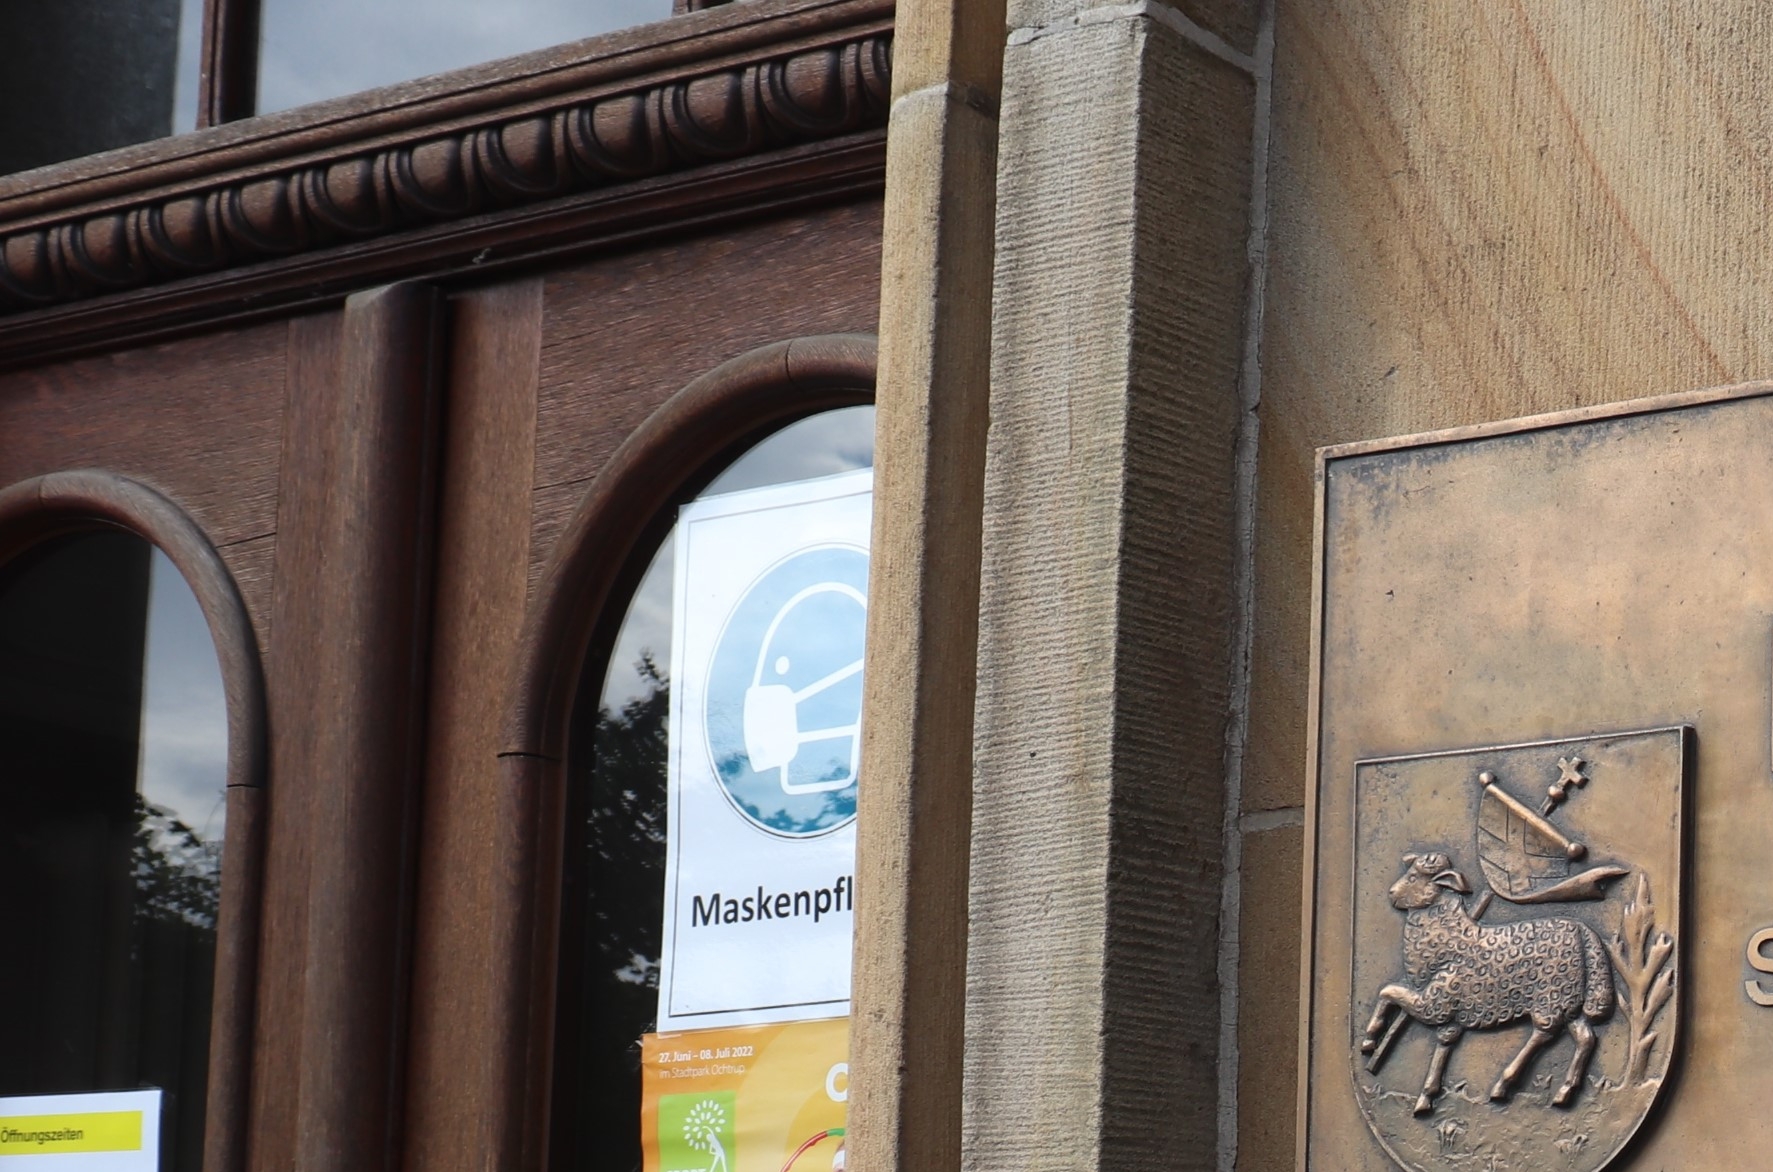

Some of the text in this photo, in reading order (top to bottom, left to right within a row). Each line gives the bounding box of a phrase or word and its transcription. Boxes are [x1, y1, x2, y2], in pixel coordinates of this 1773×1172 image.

[692, 876, 852, 927] Maskenpfl
[659, 1046, 753, 1063] 27. Juni 08. Juli 2022
[660, 1064, 745, 1079] im Stadtpark Ochtrup
[0, 1127, 84, 1144] Öffnungszeiten
